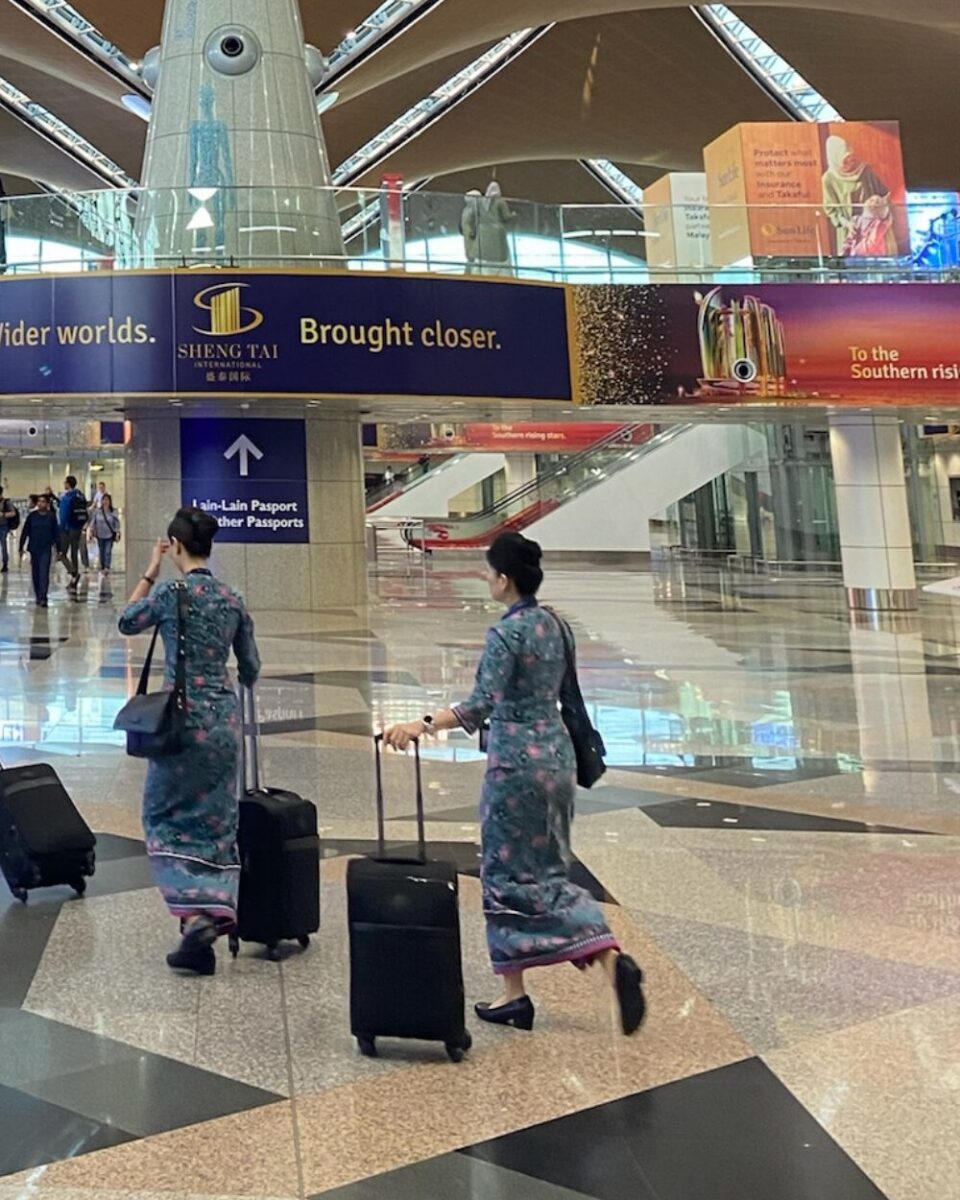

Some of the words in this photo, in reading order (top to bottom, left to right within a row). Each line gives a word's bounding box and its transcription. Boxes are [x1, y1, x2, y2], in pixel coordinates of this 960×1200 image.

[754, 149, 788, 157] Protect
[794, 159, 817, 167] most
[777, 190, 811, 198] Takaful
[56, 316, 156, 345] worlds.
[300, 318, 413, 352] Brought
[421, 320, 501, 349] closer.
[177, 343, 242, 359] SHENG
[246, 343, 279, 359] TAI
[848, 346, 868, 361] To
[872, 345, 899, 361] the
[193, 361, 262, 369] INTERNATIONAL
[851, 363, 928, 379] Southern
[931, 364, 960, 379] risi
[525, 431, 545, 441] rising
[192, 499, 248, 512] Lain-Lain
[251, 499, 298, 515] Pasport
[215, 515, 244, 528] ther
[247, 515, 304, 531] Passports
